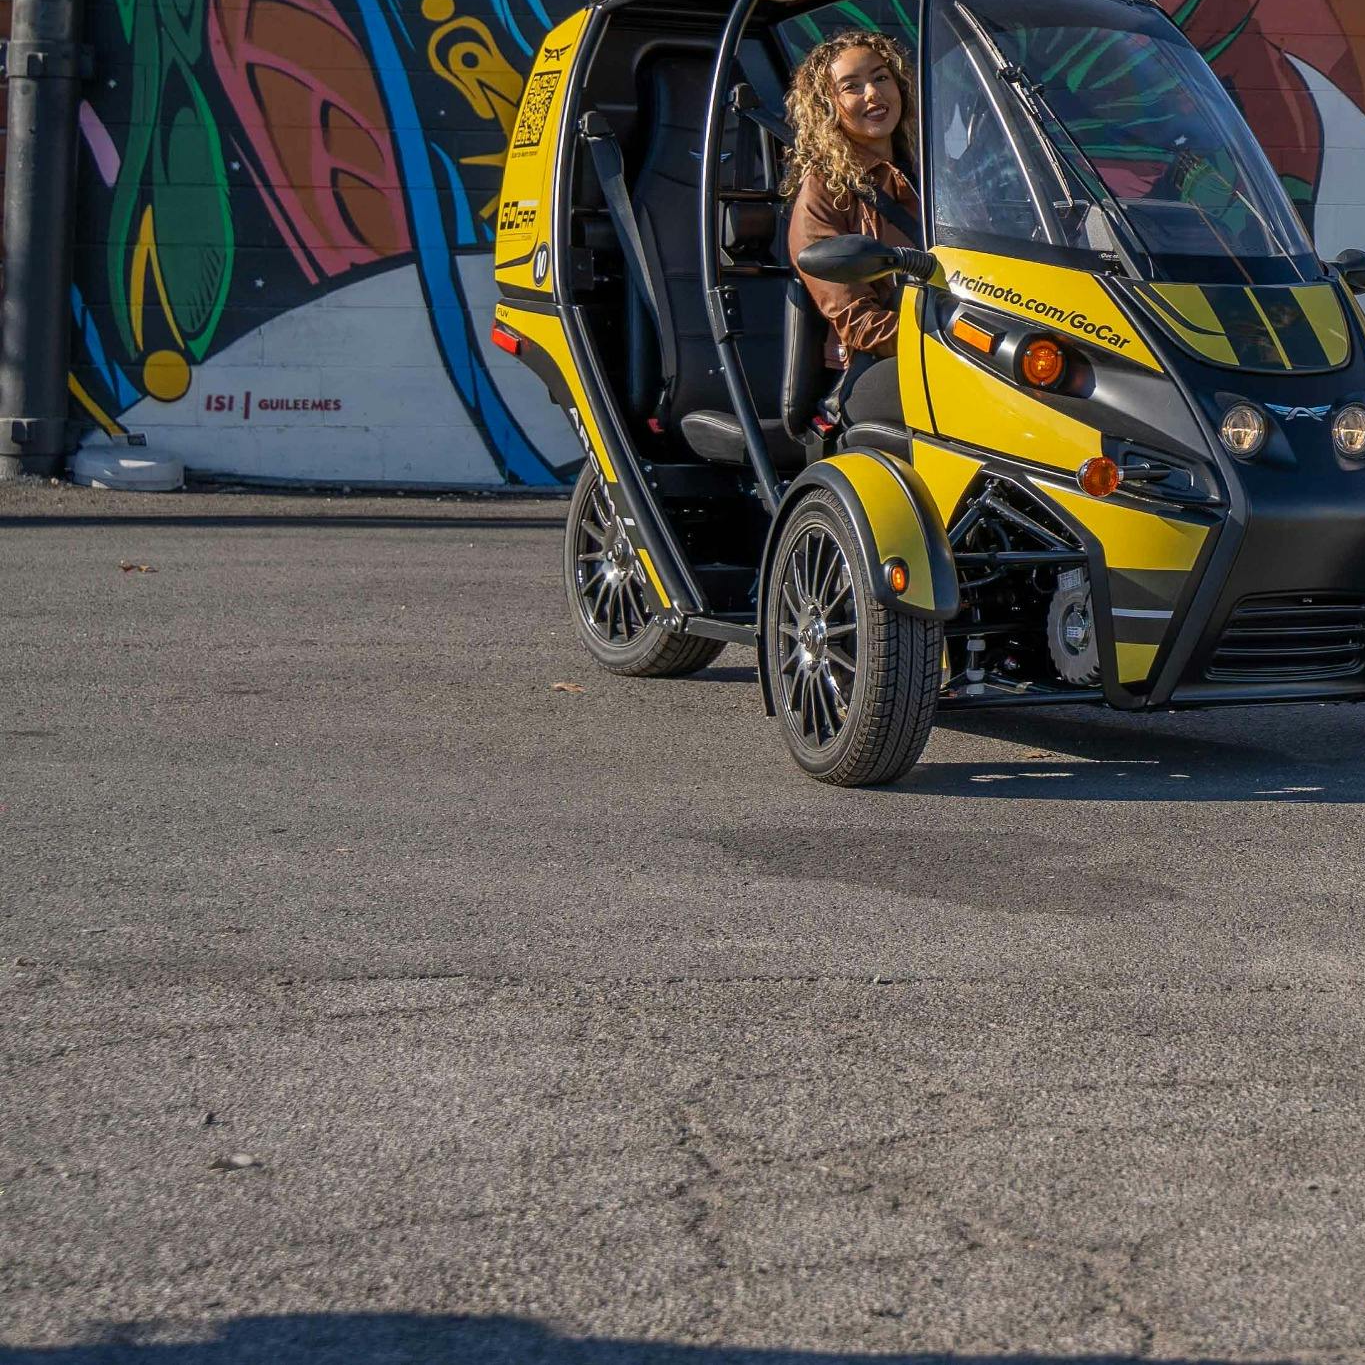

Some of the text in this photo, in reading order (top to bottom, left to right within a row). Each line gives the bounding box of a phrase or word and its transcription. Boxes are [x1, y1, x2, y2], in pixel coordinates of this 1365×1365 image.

[535, 250, 548, 279] 10
[948, 269, 1132, 350] Arcimoto.com/GoCar
[205, 394, 342, 412] ISI GUILEEMES
